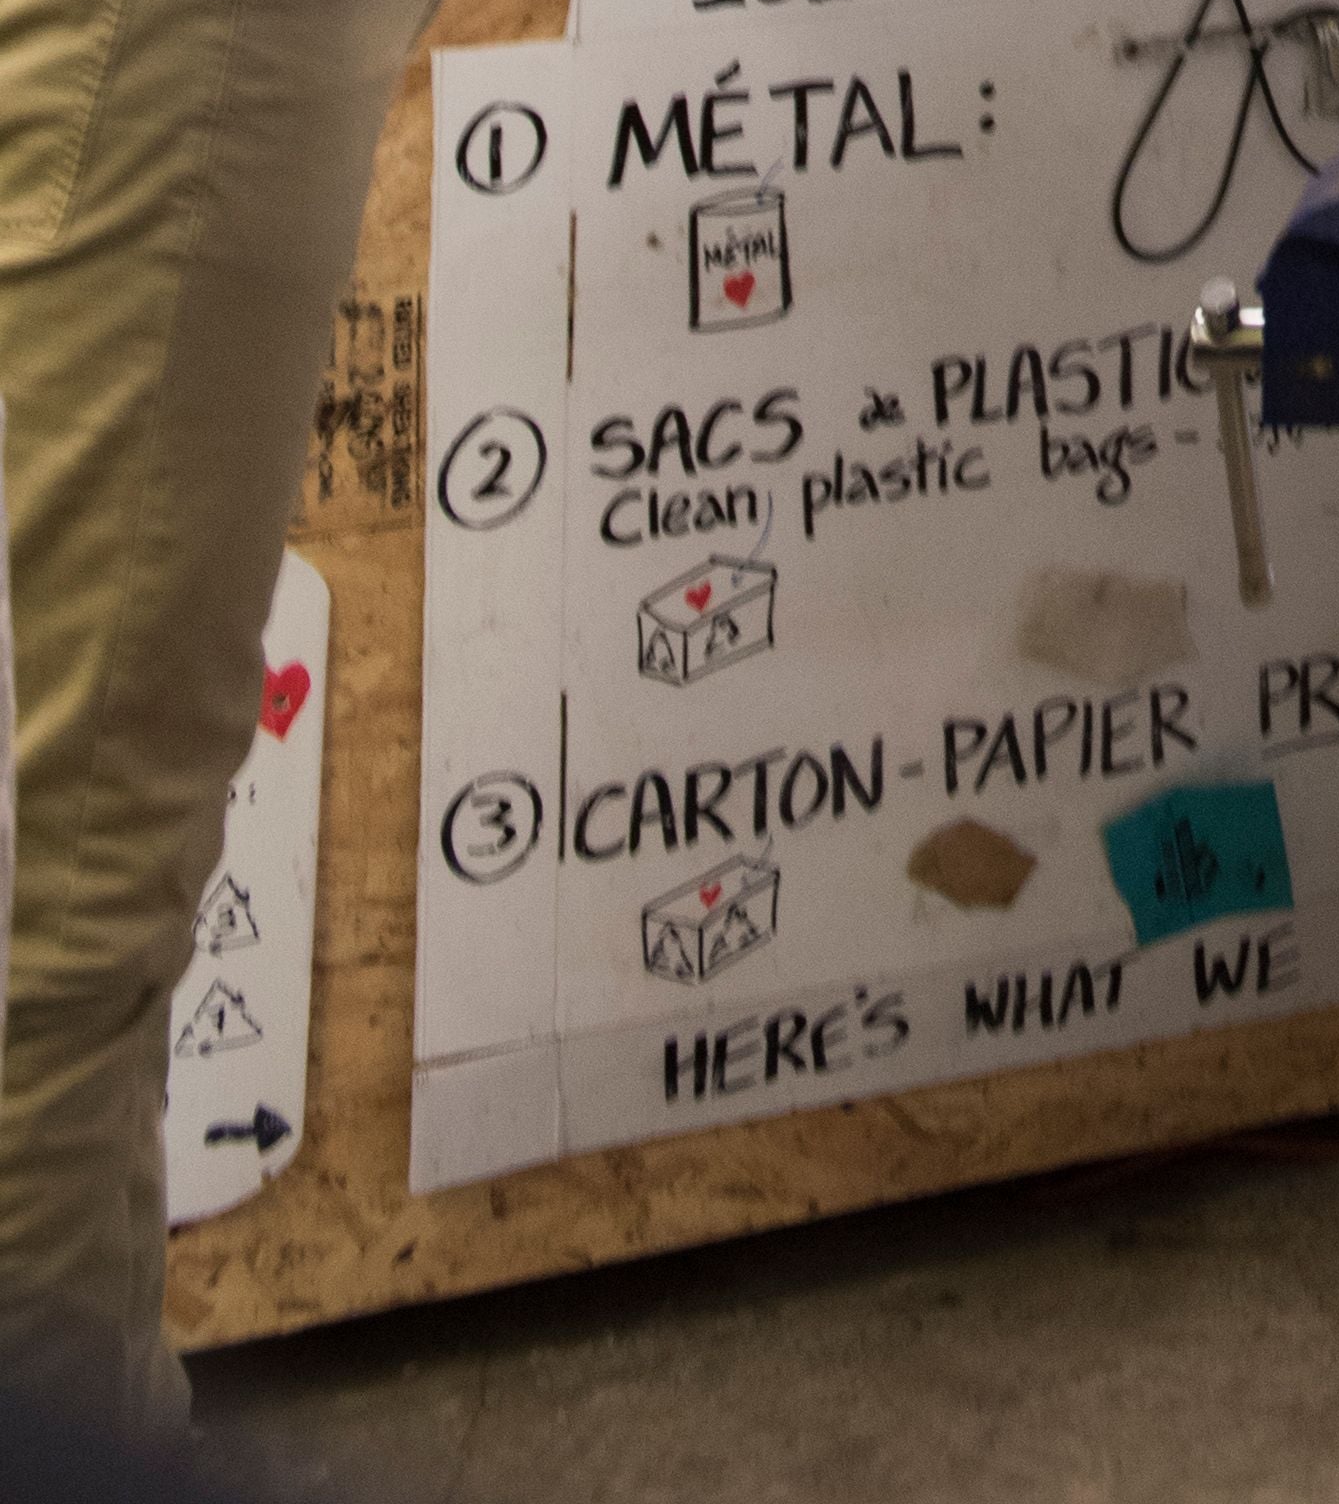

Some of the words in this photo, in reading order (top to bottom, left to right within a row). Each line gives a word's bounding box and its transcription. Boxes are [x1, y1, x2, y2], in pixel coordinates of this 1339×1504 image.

[589, 388, 806, 481] SACS
[600, 488, 760, 548] Clean
[801, 434, 991, 540] plastic
[663, 985, 912, 1103] HERE'S
[964, 945, 1145, 1036] WHAT
[1194, 922, 1302, 1004] WE
